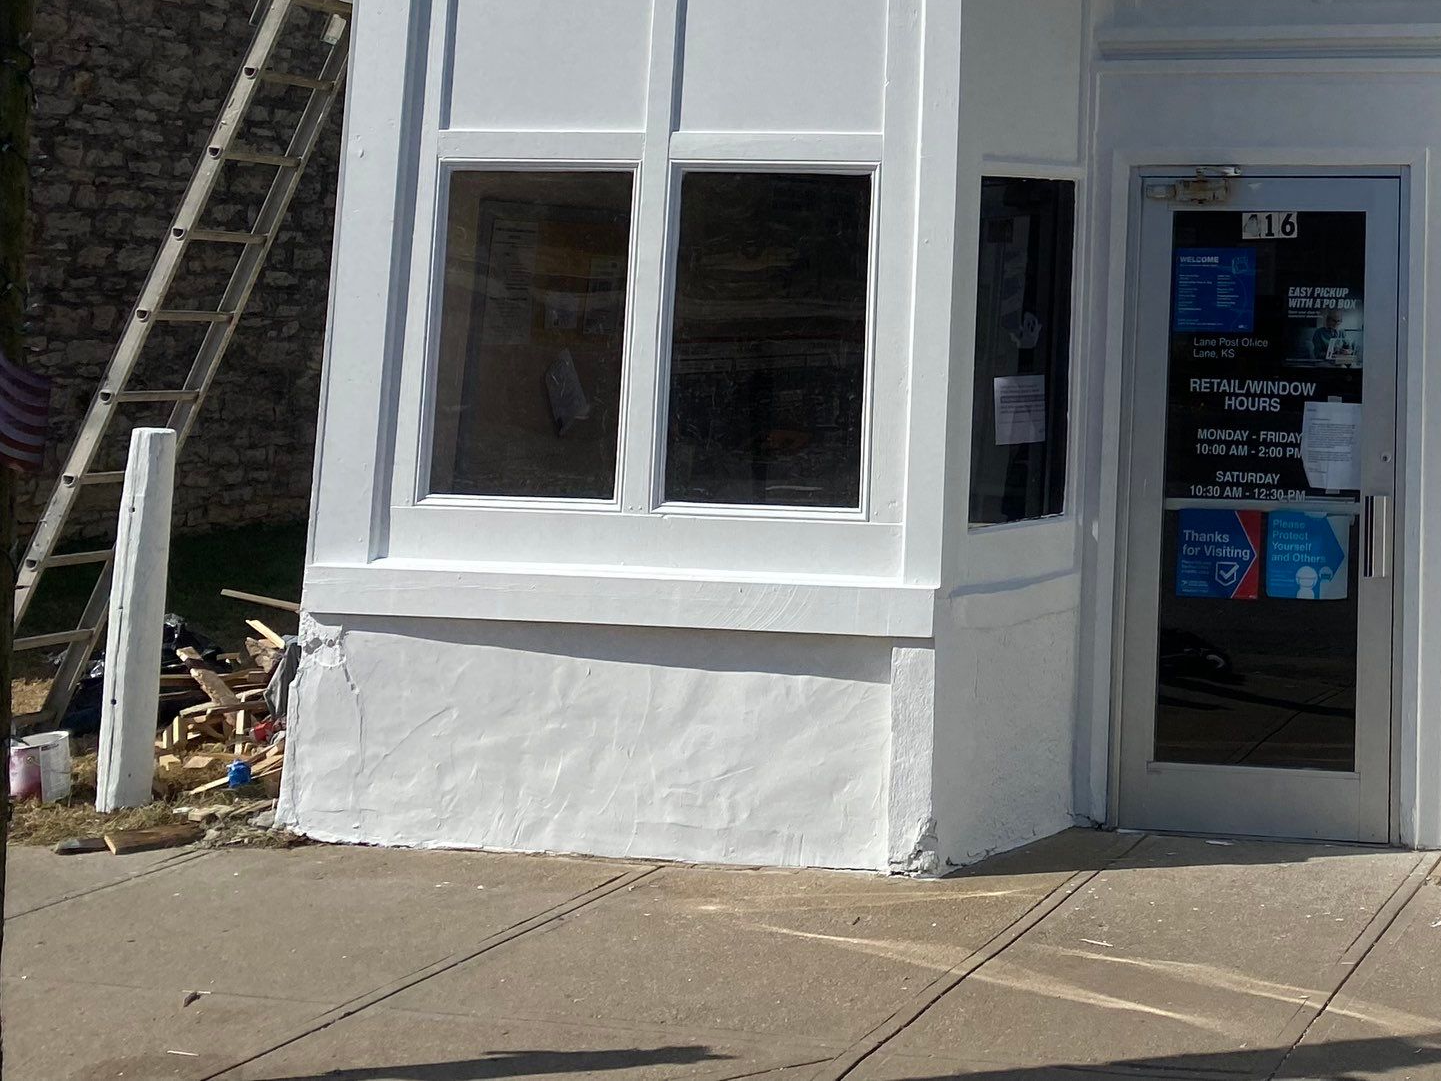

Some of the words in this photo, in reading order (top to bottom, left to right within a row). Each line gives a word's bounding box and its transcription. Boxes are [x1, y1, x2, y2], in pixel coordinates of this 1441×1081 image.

[1288, 287, 1313, 297] EASY
[1314, 287, 1350, 298] PICKUP
[1288, 298, 1313, 308] WITH
[1314, 299, 1321, 308] A
[1323, 299, 1336, 309] PO
[1337, 299, 1357, 309] BOX
[1193, 337, 1217, 346] Lane
[1219, 337, 1239, 347] Post
[1193, 349, 1218, 359] Lane,
[1221, 349, 1235, 358] KS
[1190, 378, 1316, 396] RETAIL/WINDOW
[1224, 396, 1281, 412] HOURS
[1197, 429, 1250, 441] MONDAY
[1260, 431, 1303, 444] FRIDAY
[1195, 443, 1226, 455] 10:00
[1229, 445, 1248, 456] AM
[1258, 446, 1283, 458] 2:00
[1216, 471, 1280, 484] SATURDAY
[1190, 485, 1220, 497] 10:30
[1223, 486, 1243, 498] AM
[1253, 488, 1283, 500] 12:30
[1286, 490, 1306, 501] PM
[1272, 519, 1306, 529] Please
[1183, 529, 1229, 543] Thanks
[1272, 530, 1308, 540] Protect
[1182, 544, 1201, 556] for
[1203, 545, 1251, 561] Visiting
[1272, 541, 1312, 552] Yourself
[1271, 553, 1290, 562] and
[1292, 553, 1326, 563] Others
